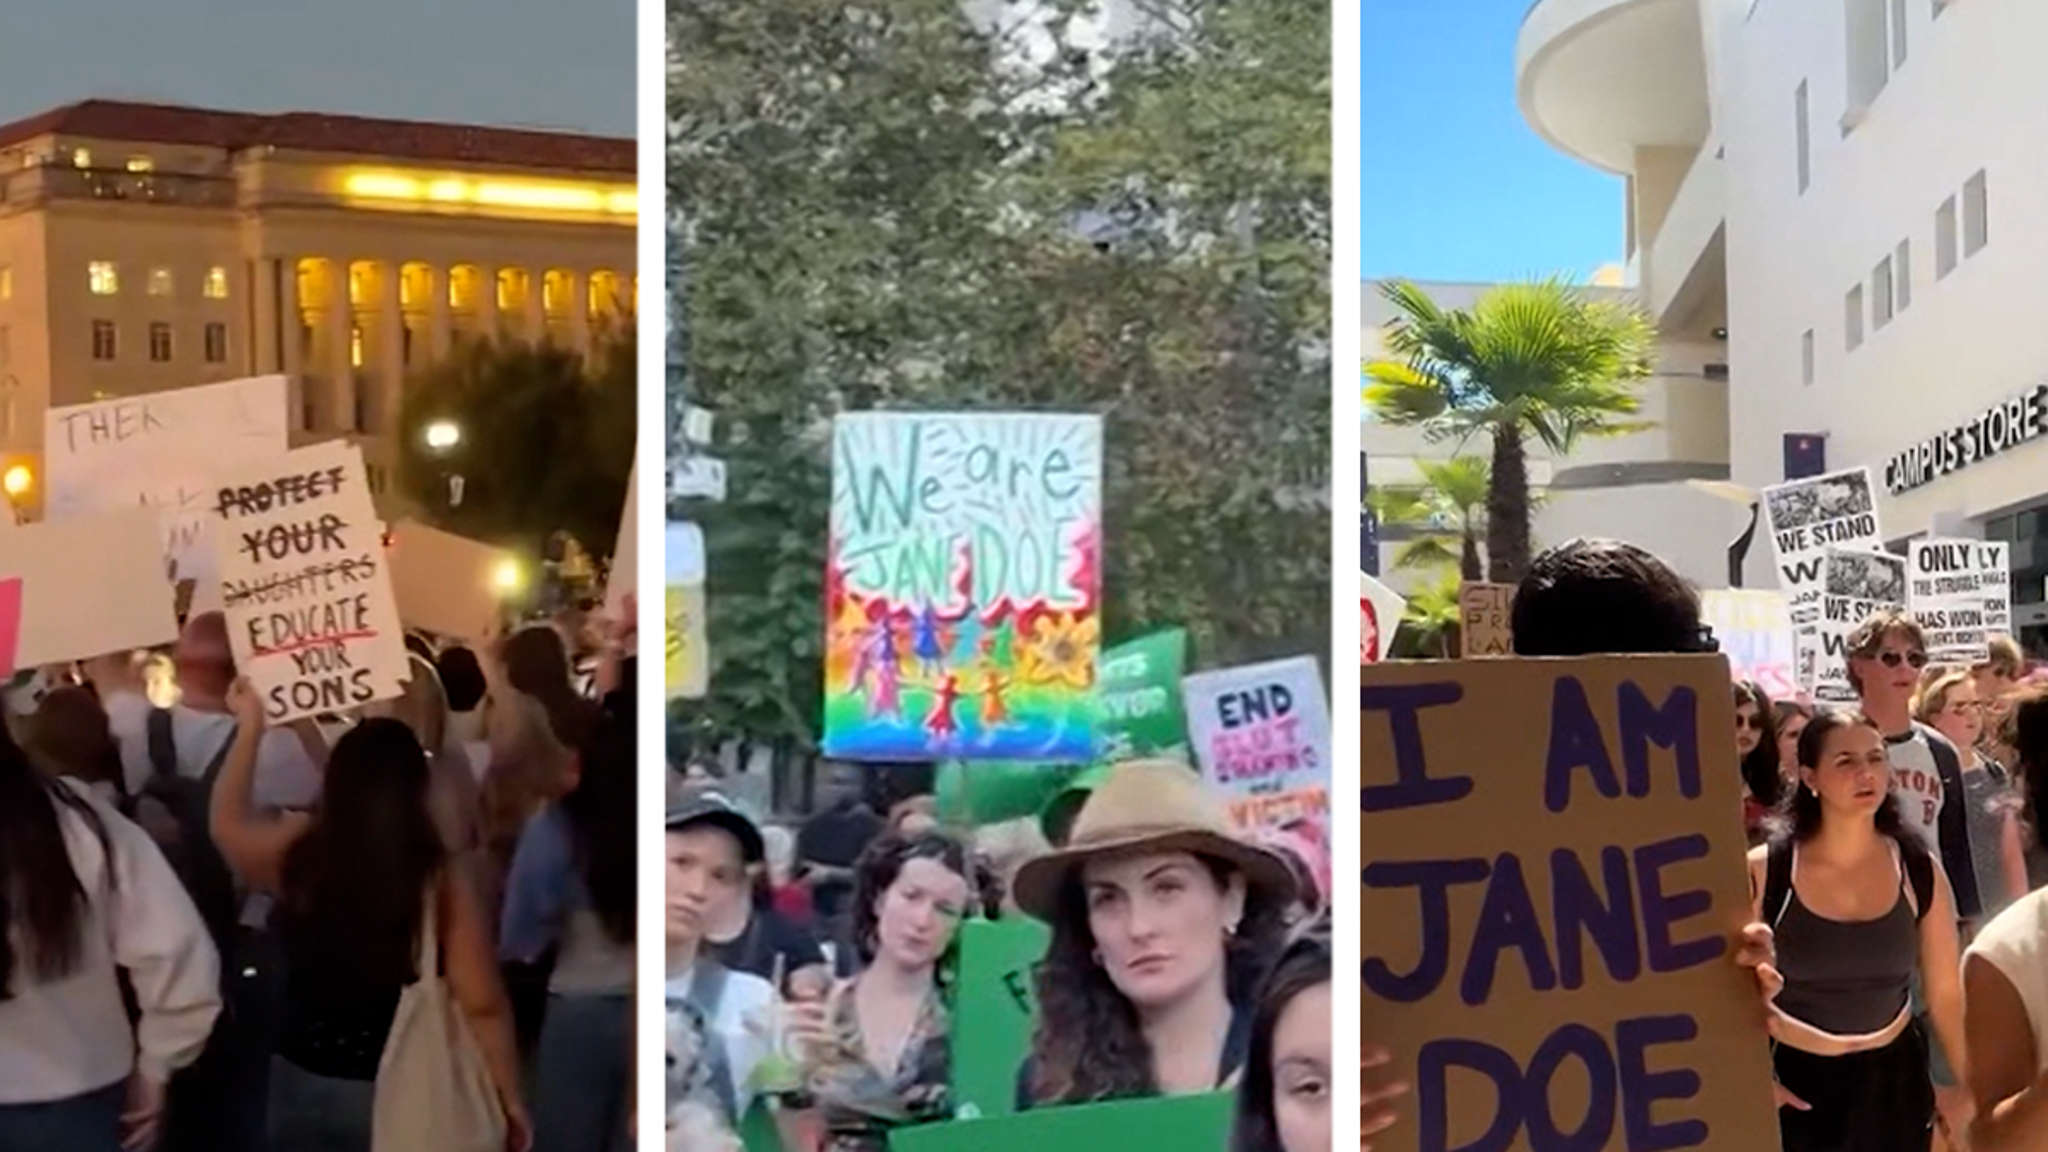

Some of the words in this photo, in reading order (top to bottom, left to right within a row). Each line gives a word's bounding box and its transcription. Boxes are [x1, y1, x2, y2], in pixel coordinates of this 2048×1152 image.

[1884, 428, 1958, 496] CAMPUS
[1963, 382, 2041, 465] STORE
[215, 465, 345, 519] PROTECT
[839, 421, 952, 534] We
[964, 444, 1081, 500] are
[240, 513, 348, 563] YOUR
[842, 532, 966, 603] JANE
[979, 515, 1086, 605] DOE
[1777, 529, 1810, 554] WE
[1812, 514, 1876, 546] STAND
[1919, 544, 1970, 572] ONLY
[222, 553, 376, 608] DAUGHTERS
[247, 592, 370, 652] EDUCATE
[1824, 595, 1851, 622] WE
[1949, 609, 1982, 628] WON
[290, 640, 352, 675] YOUR
[267, 668, 374, 718] SONS
[1217, 684, 1293, 728] END
[1360, 680, 1475, 813] I
[1544, 675, 1702, 813] AM
[1362, 833, 1728, 1006] JANE
[1417, 1013, 1709, 1152] DOE
